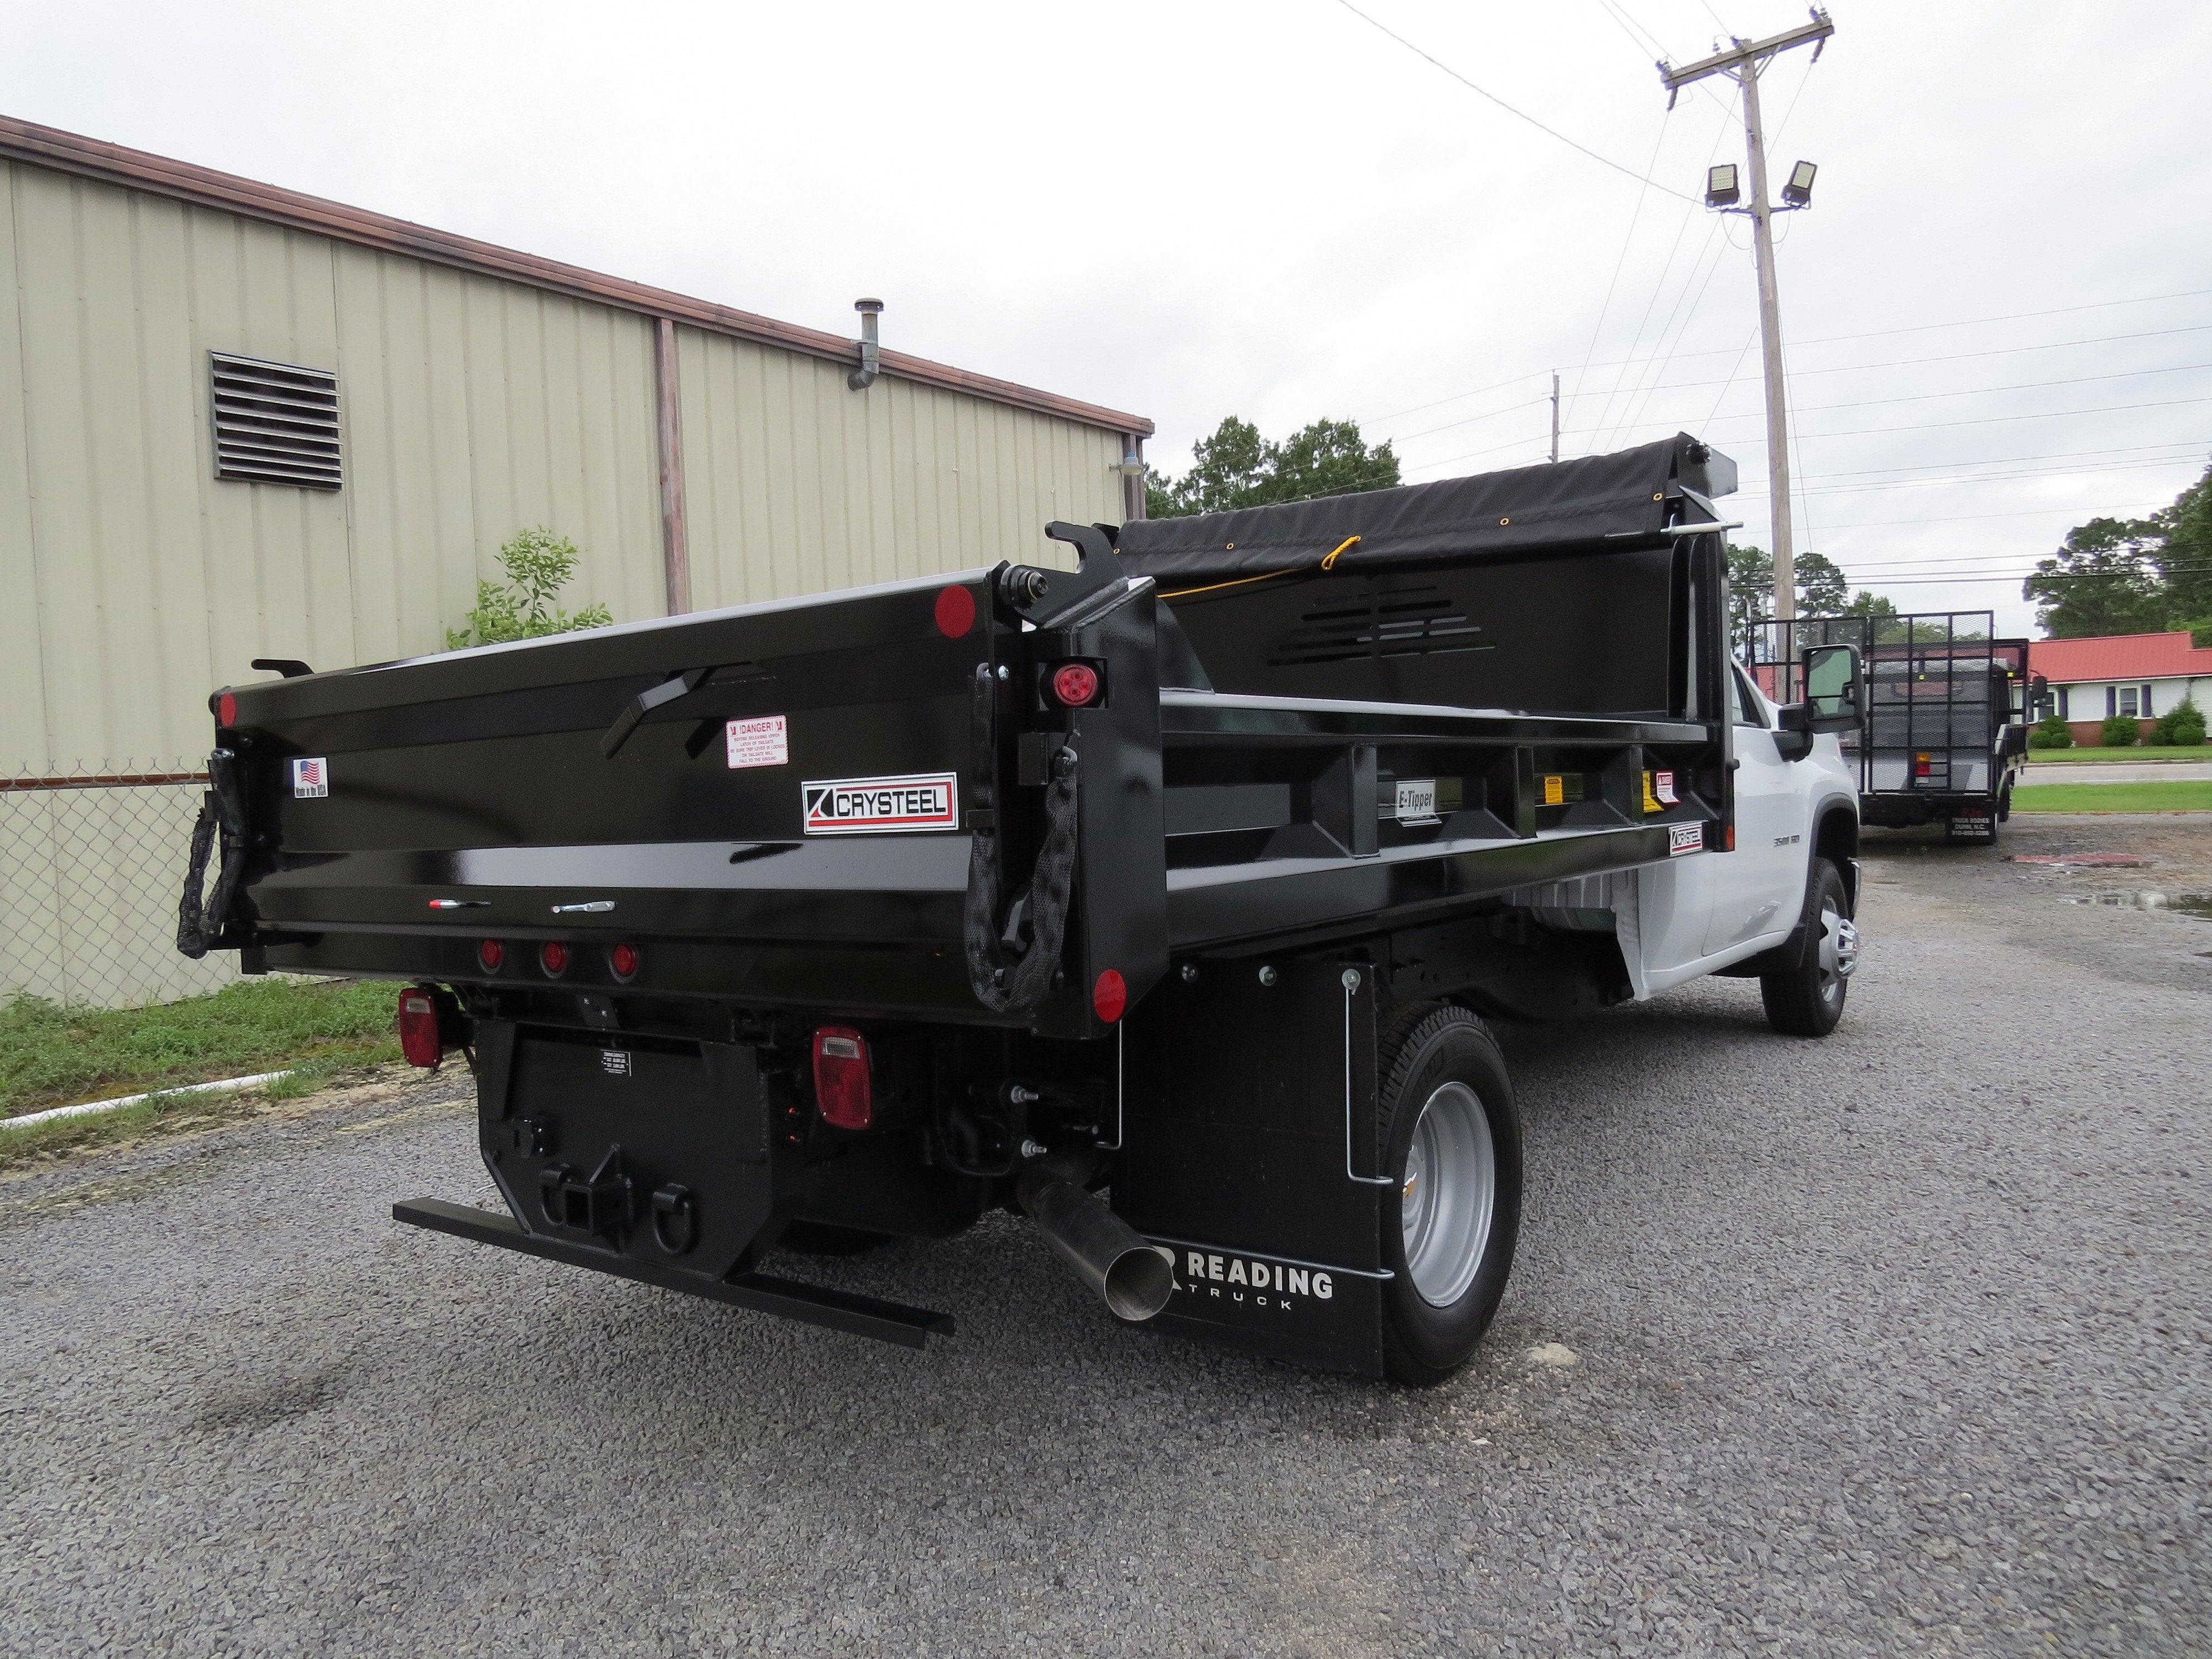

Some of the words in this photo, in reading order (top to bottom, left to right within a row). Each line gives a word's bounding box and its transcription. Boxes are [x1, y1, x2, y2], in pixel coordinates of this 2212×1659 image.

[836, 789, 946, 817] CRYSTEEL
[1399, 790, 1433, 811] E-Tipper
[1187, 1251, 1333, 1300] READING
[1188, 1284, 1292, 1311] TRUCK
